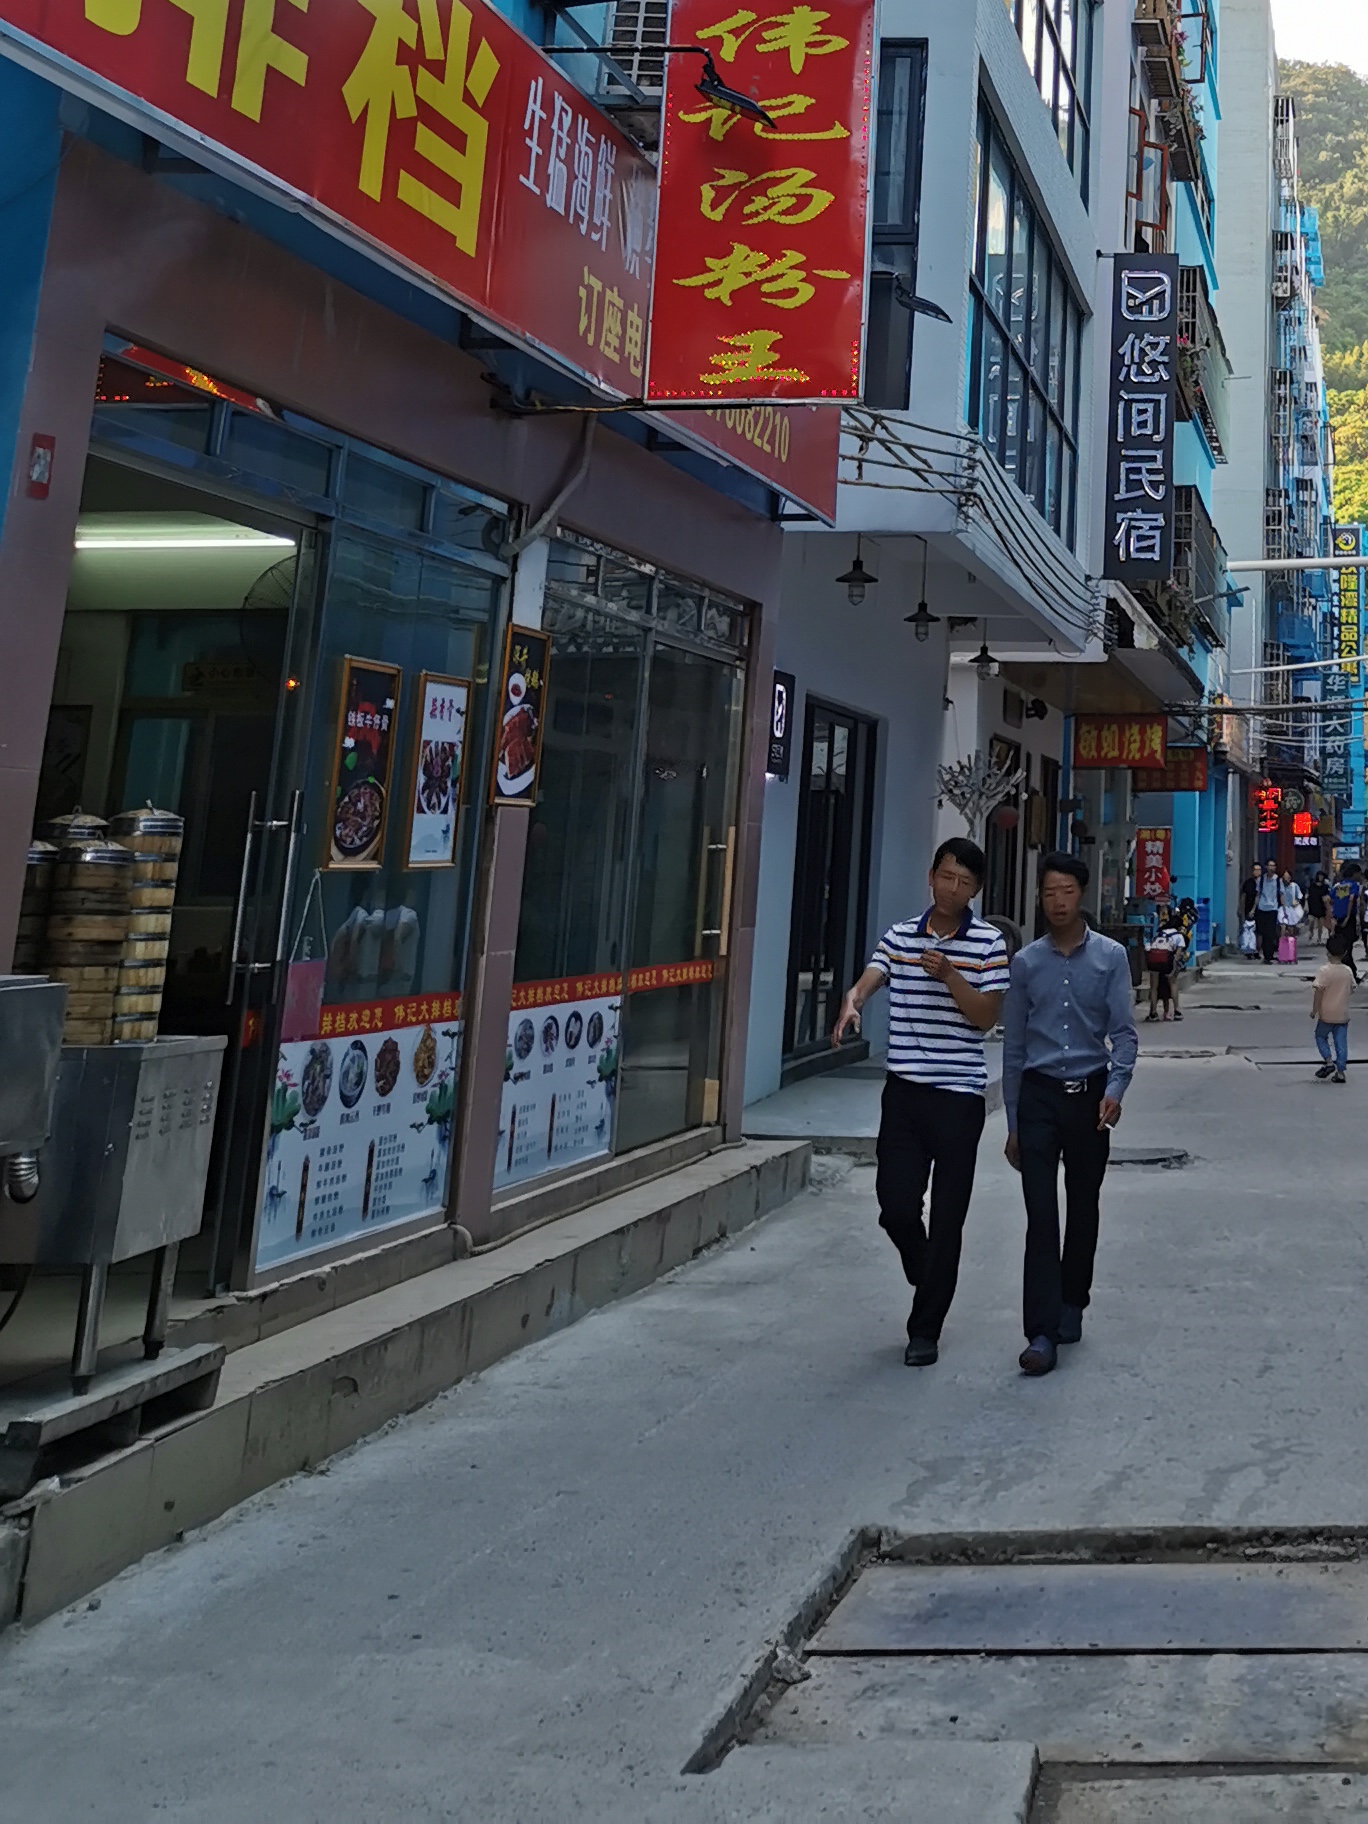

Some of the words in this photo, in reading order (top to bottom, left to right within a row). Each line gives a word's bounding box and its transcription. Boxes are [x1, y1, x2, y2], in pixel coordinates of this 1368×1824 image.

[519, 75, 617, 252] 生猛海鲜
[672, 4, 850, 385] 伟记汤粉王
[1113, 332, 1171, 562] 悠间民宿
[1144, 840, 1166, 895] 精美小炒
